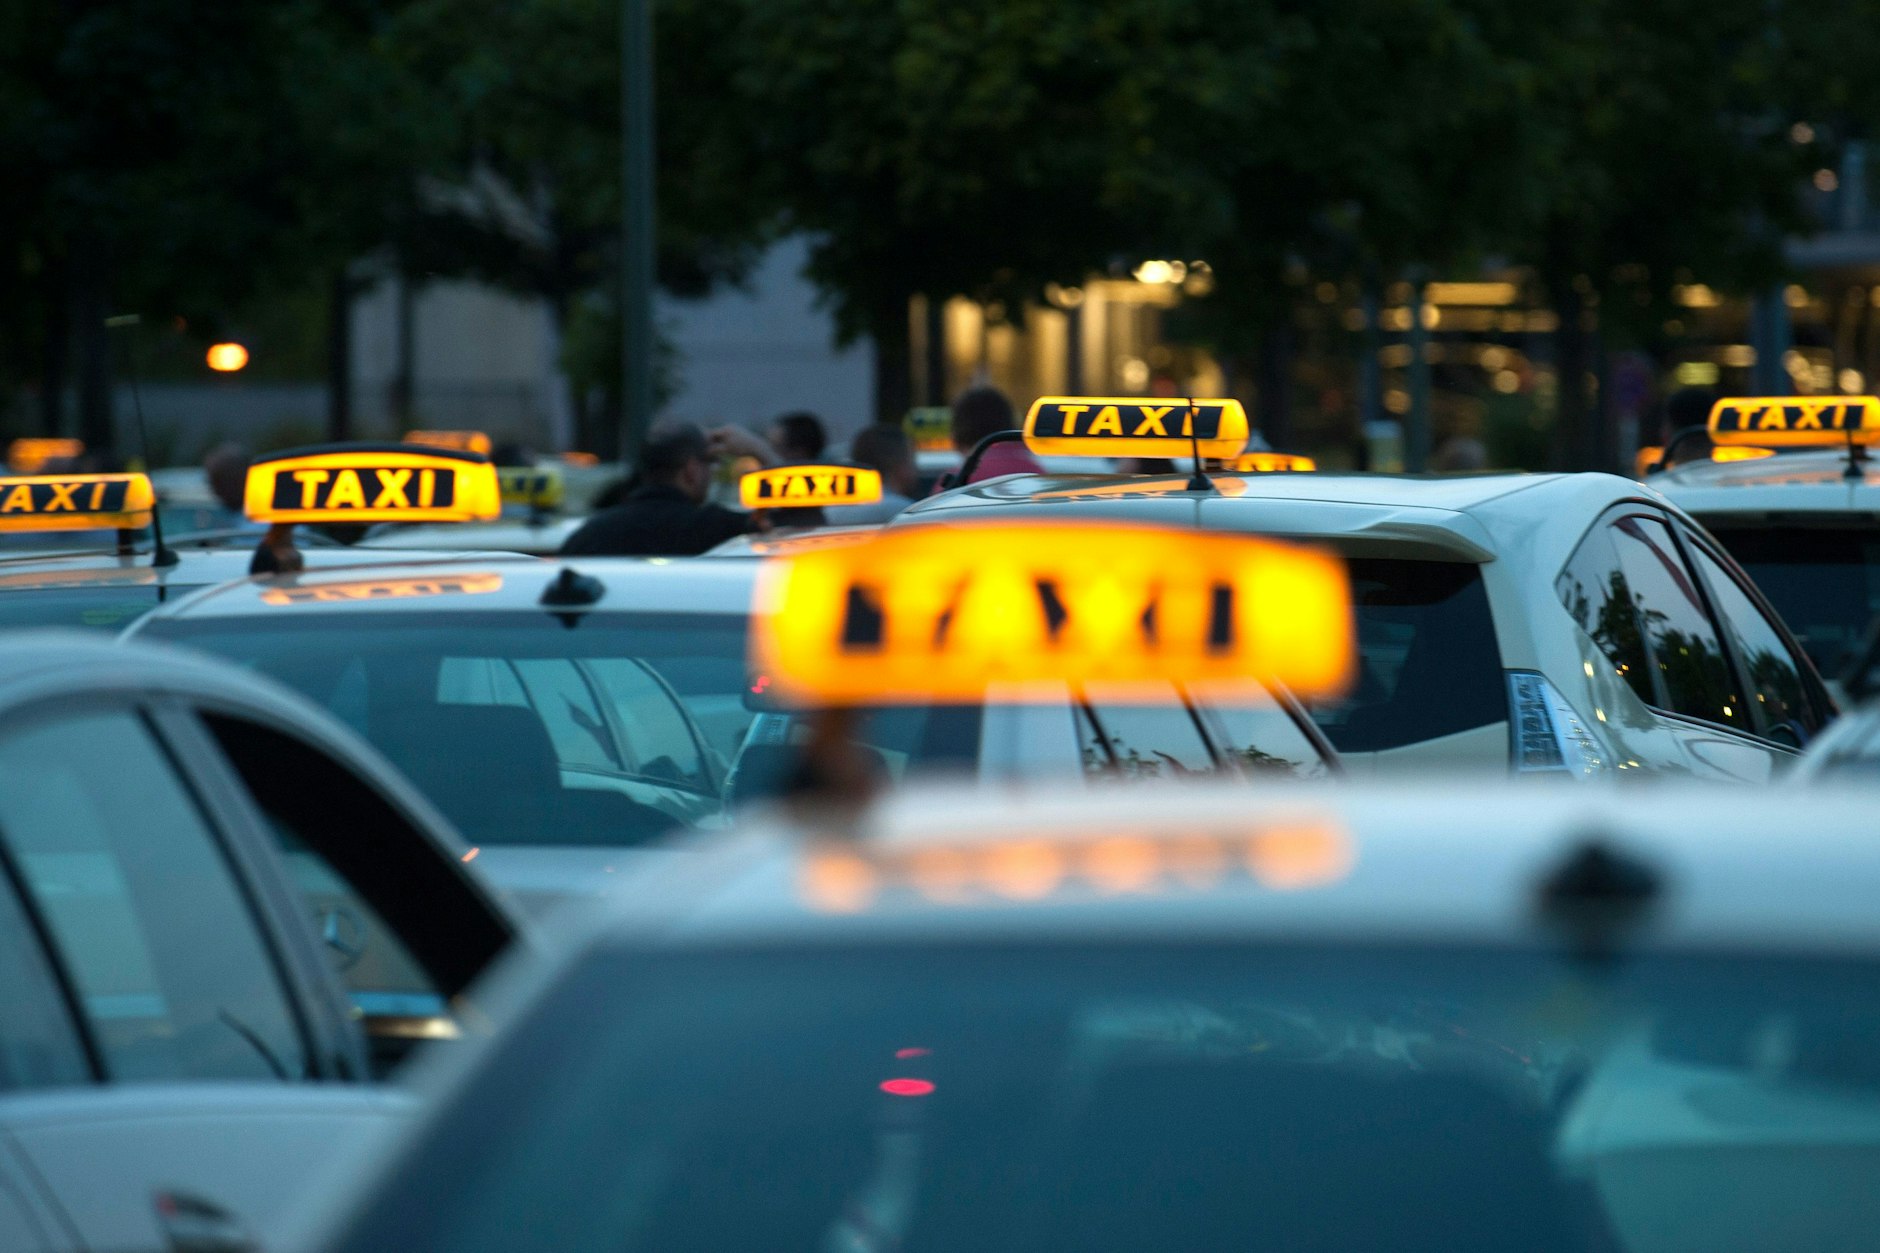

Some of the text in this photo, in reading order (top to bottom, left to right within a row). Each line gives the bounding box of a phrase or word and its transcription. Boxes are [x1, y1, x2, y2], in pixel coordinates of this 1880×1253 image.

[1058, 405, 1200, 436] TAXI
[1735, 405, 1847, 430] TAXI
[0, 483, 107, 512] AXI
[293, 469, 436, 508] TAXI
[766, 475, 848, 497] TAXI
[862, 575, 1208, 650] TAXI
